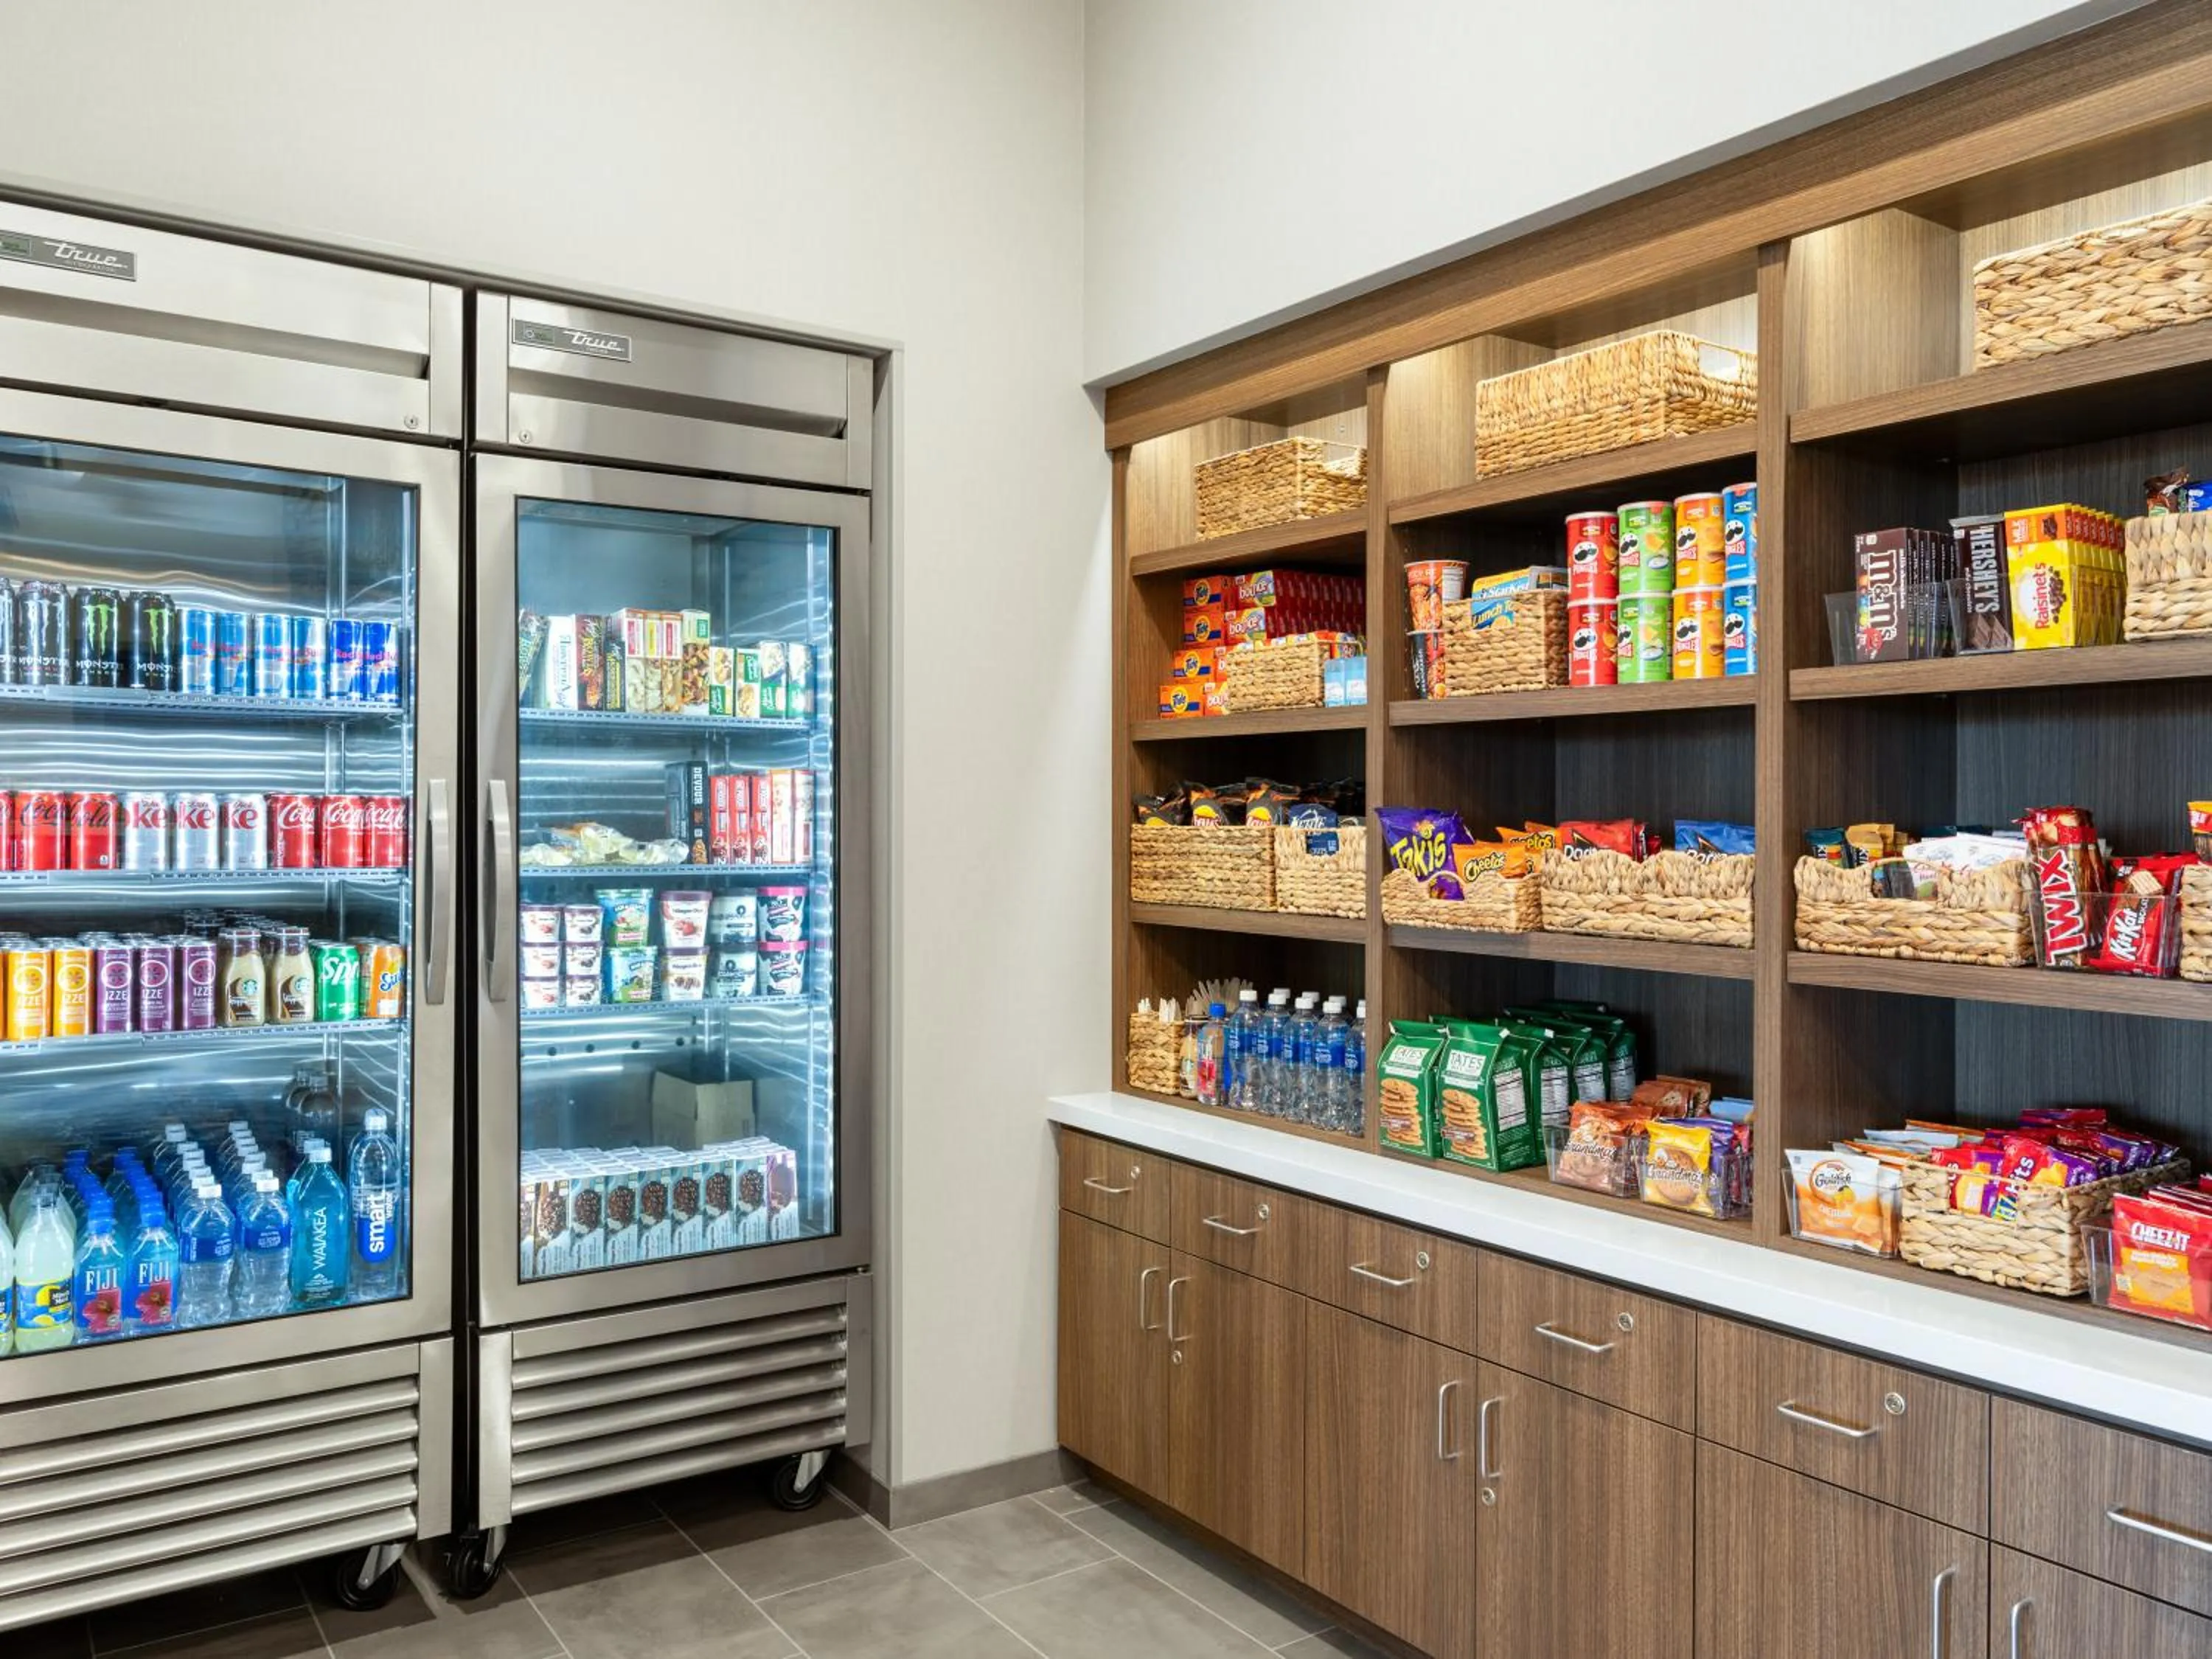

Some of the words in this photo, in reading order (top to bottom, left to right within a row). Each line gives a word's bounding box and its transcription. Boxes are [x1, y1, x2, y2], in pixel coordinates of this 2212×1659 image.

[1970, 524, 2000, 613] HERSHEY'S
[693, 766, 703, 805] DEVOUR
[2033, 849, 2087, 966] TWIX
[321, 956, 359, 985] Spr
[105, 990, 128, 1001] IZZE
[142, 989, 164, 999] IZZE
[193, 986, 213, 996] IZZE
[369, 1193, 386, 1253] smart
[313, 1207, 327, 1270] WAIAKEA
[86, 1267, 118, 1292] FIJI
[138, 1261, 170, 1284] FIJI
